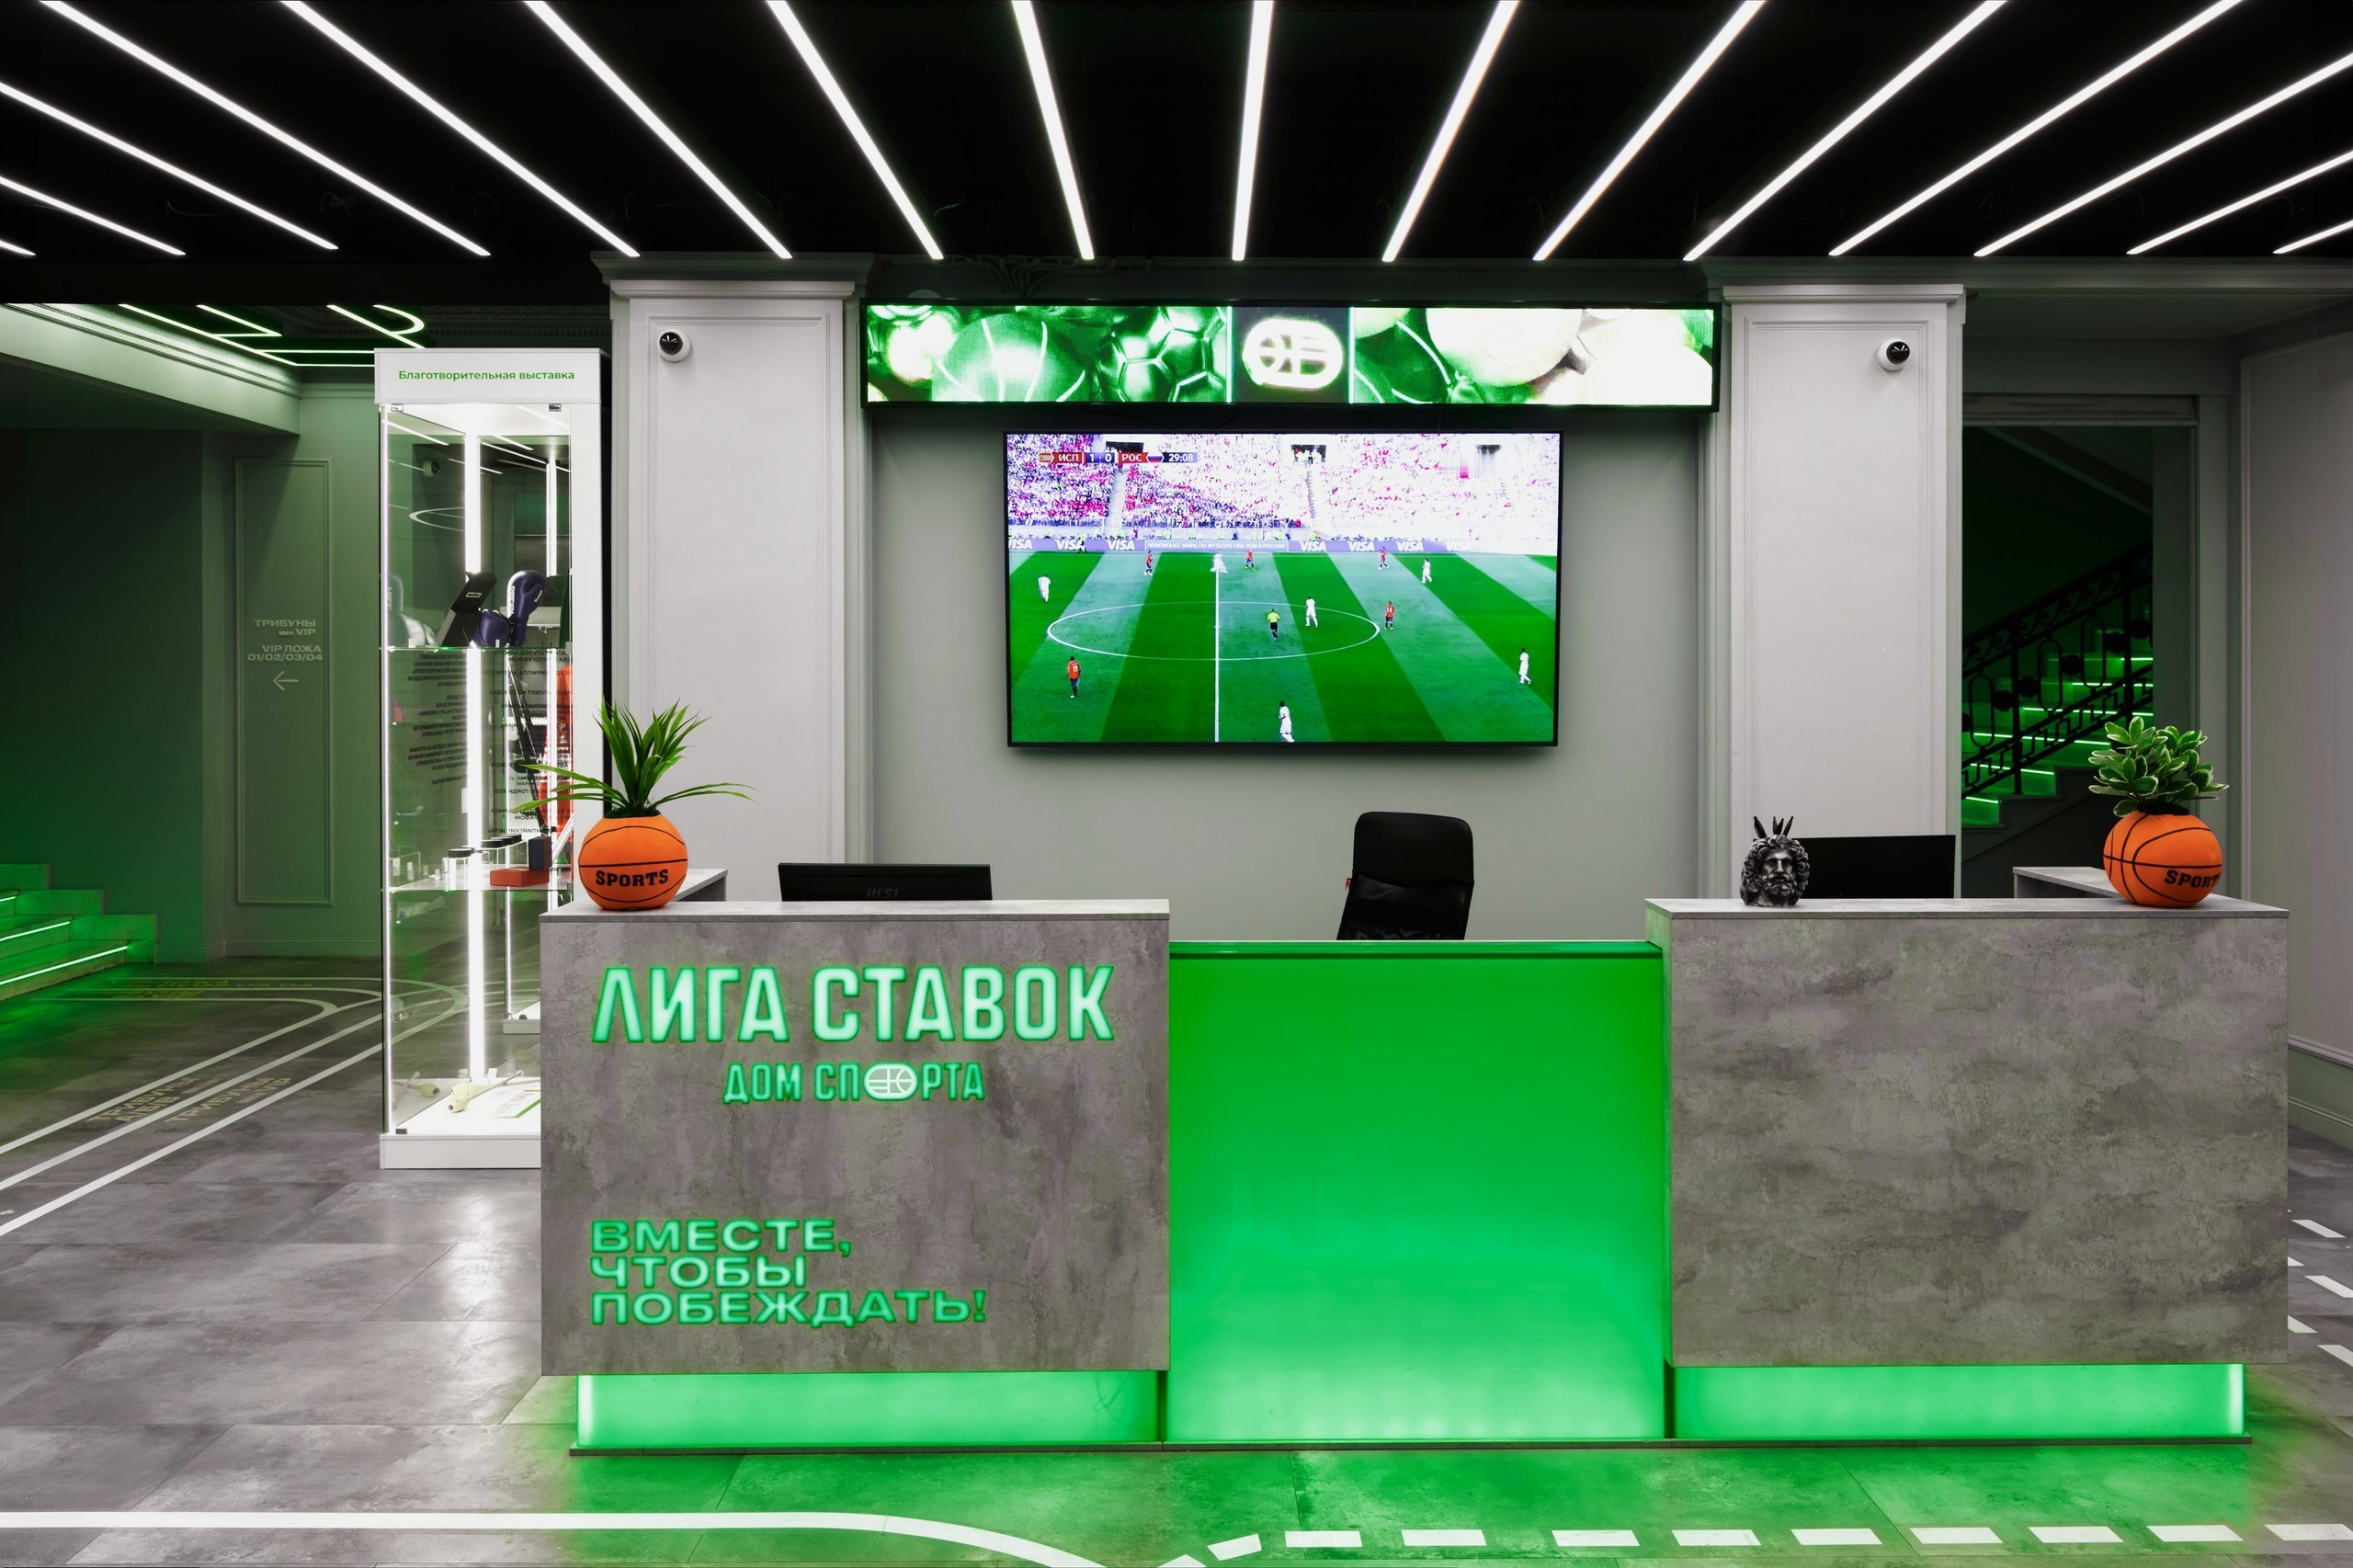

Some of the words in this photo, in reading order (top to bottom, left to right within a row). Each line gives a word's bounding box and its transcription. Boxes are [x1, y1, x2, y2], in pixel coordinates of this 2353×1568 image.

[398, 370, 516, 381] Благотворительная
[1058, 454, 1079, 462] ИСП
[1121, 454, 1142, 462] РОС
[1168, 453, 1194, 462] 29:08
[1106, 540, 1135, 551] VISA
[1299, 540, 1327, 551] VISA
[1347, 540, 1375, 551] VISA
[1395, 540, 1424, 551] VISA
[295, 628, 316, 636] VIP
[247, 653, 324, 662] 01/02/03/04
[596, 869, 669, 887] SPORTS
[591, 966, 790, 1043] ЛИГА
[811, 965, 1116, 1042] СТАВОК
[722, 1062, 803, 1104] ДОМ
[813, 1062, 986, 1102] СПОРТА
[164, 1077, 276, 1122] ТРИБУНЫ
[590, 1218, 852, 1257] ВМЕСТЕ,
[590, 1256, 807, 1288] ЧТОБЫ
[591, 1290, 987, 1329] ПОБЕЖДАТЬ!
